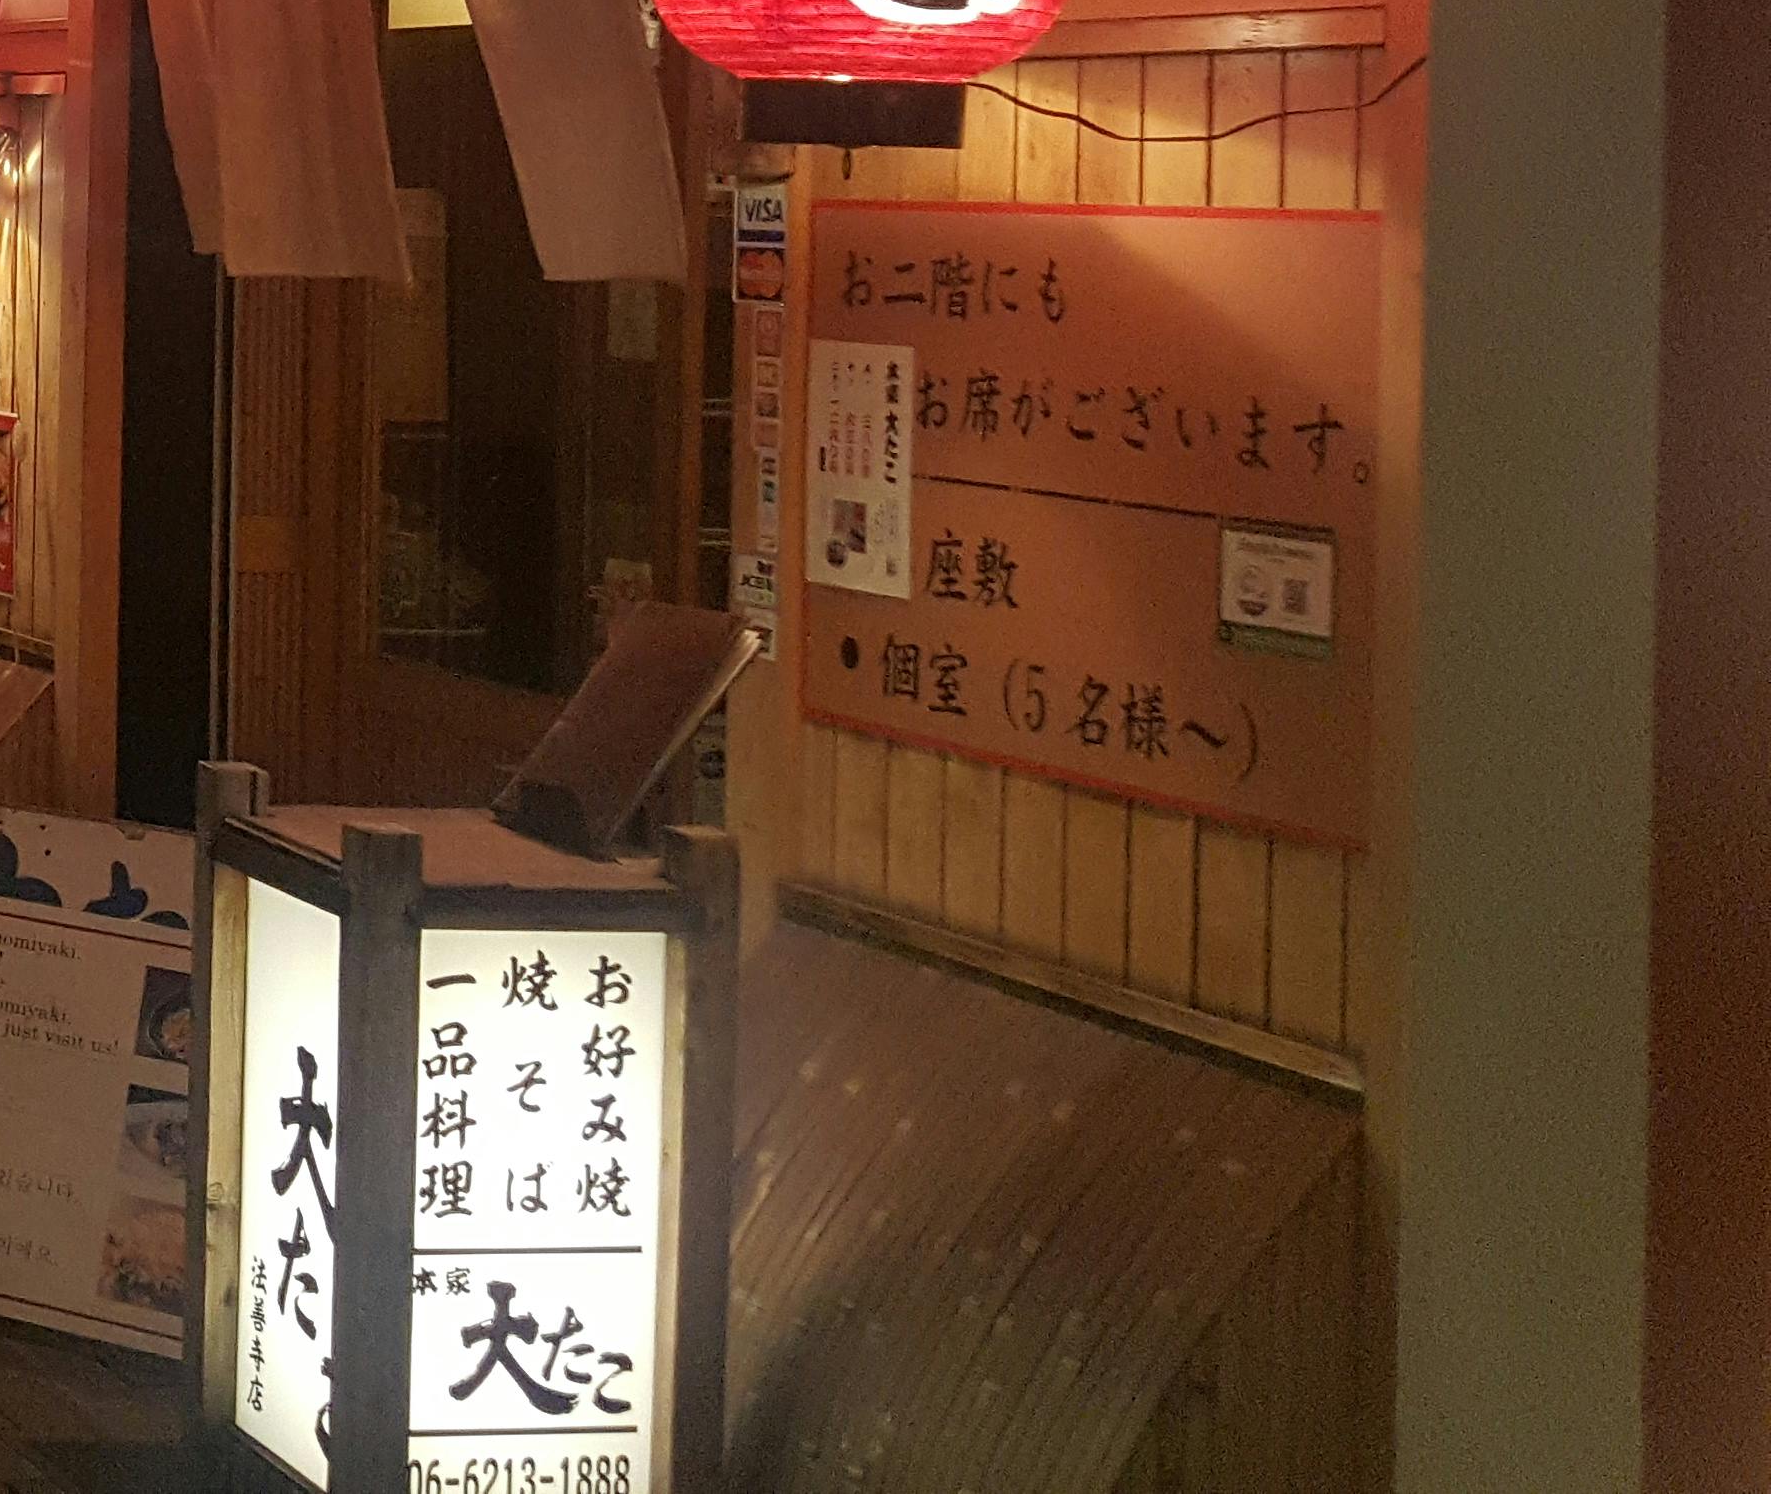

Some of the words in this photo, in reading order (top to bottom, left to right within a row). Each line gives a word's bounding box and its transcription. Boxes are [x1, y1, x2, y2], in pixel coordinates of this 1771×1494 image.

[744, 199, 784, 223] VISA
[842, 252, 1066, 322] お二階にも
[916, 366, 1372, 484] お席がございます。
[926, 529, 1020, 609] 座敷
[3, 1019, 38, 1043] just
[45, 1029, 83, 1050] visit
[91, 1036, 119, 1055] us!
[420, 971, 477, 1220] 一品料理
[502, 949, 559, 1215] 焼そば
[577, 954, 637, 1219] お好み焼
[271, 1045, 337, 1457] 大た
[413, 1267, 473, 1296] 本家
[246, 1255, 268, 1412] 法善寺店
[449, 1281, 633, 1415] 大たこ
[408, 1455, 632, 1494] 06-6213-1888
